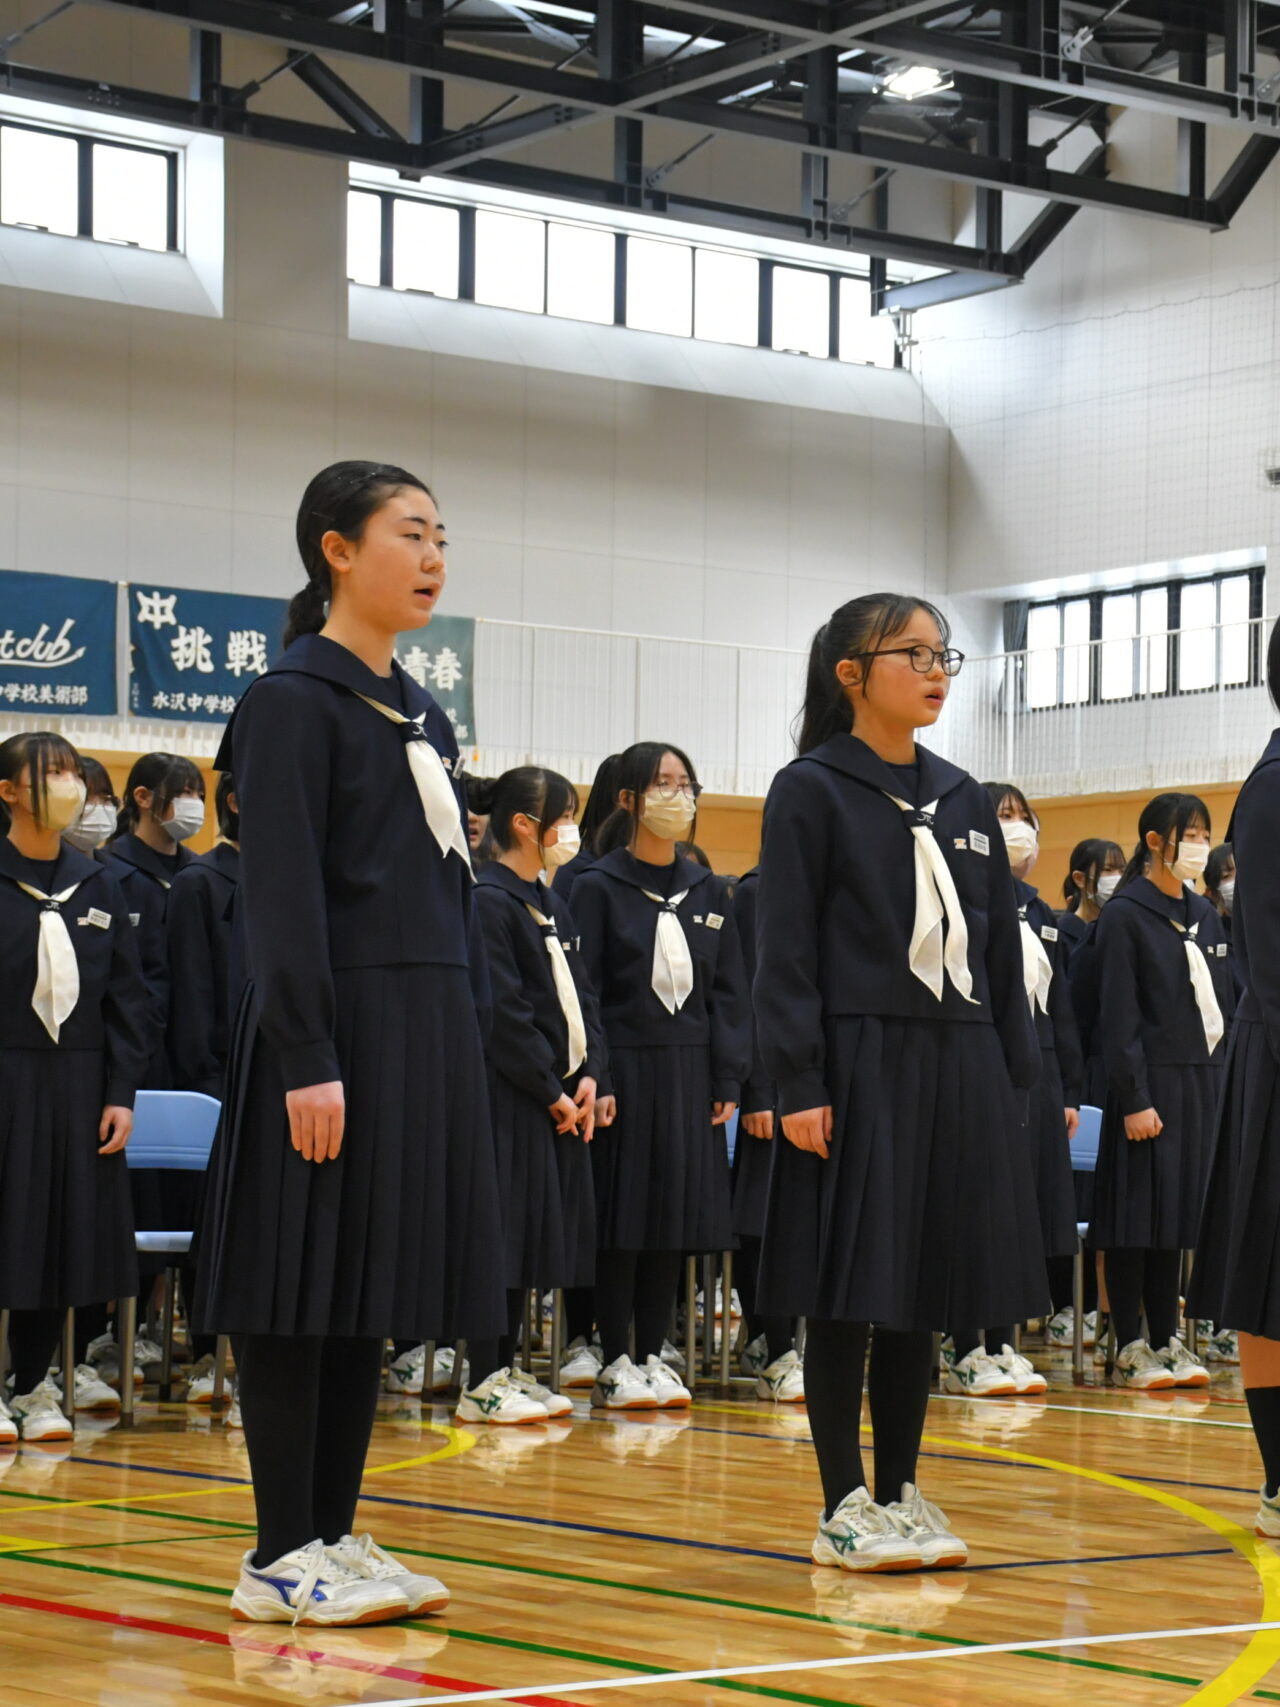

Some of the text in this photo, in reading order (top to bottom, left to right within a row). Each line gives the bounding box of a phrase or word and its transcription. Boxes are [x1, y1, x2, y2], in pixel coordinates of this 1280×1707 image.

[170, 624, 269, 677] 挑戦
[392, 646, 463, 690] 青春
[0, 683, 88, 706] 学校美術部
[152, 690, 242, 714] 水沢中学校
